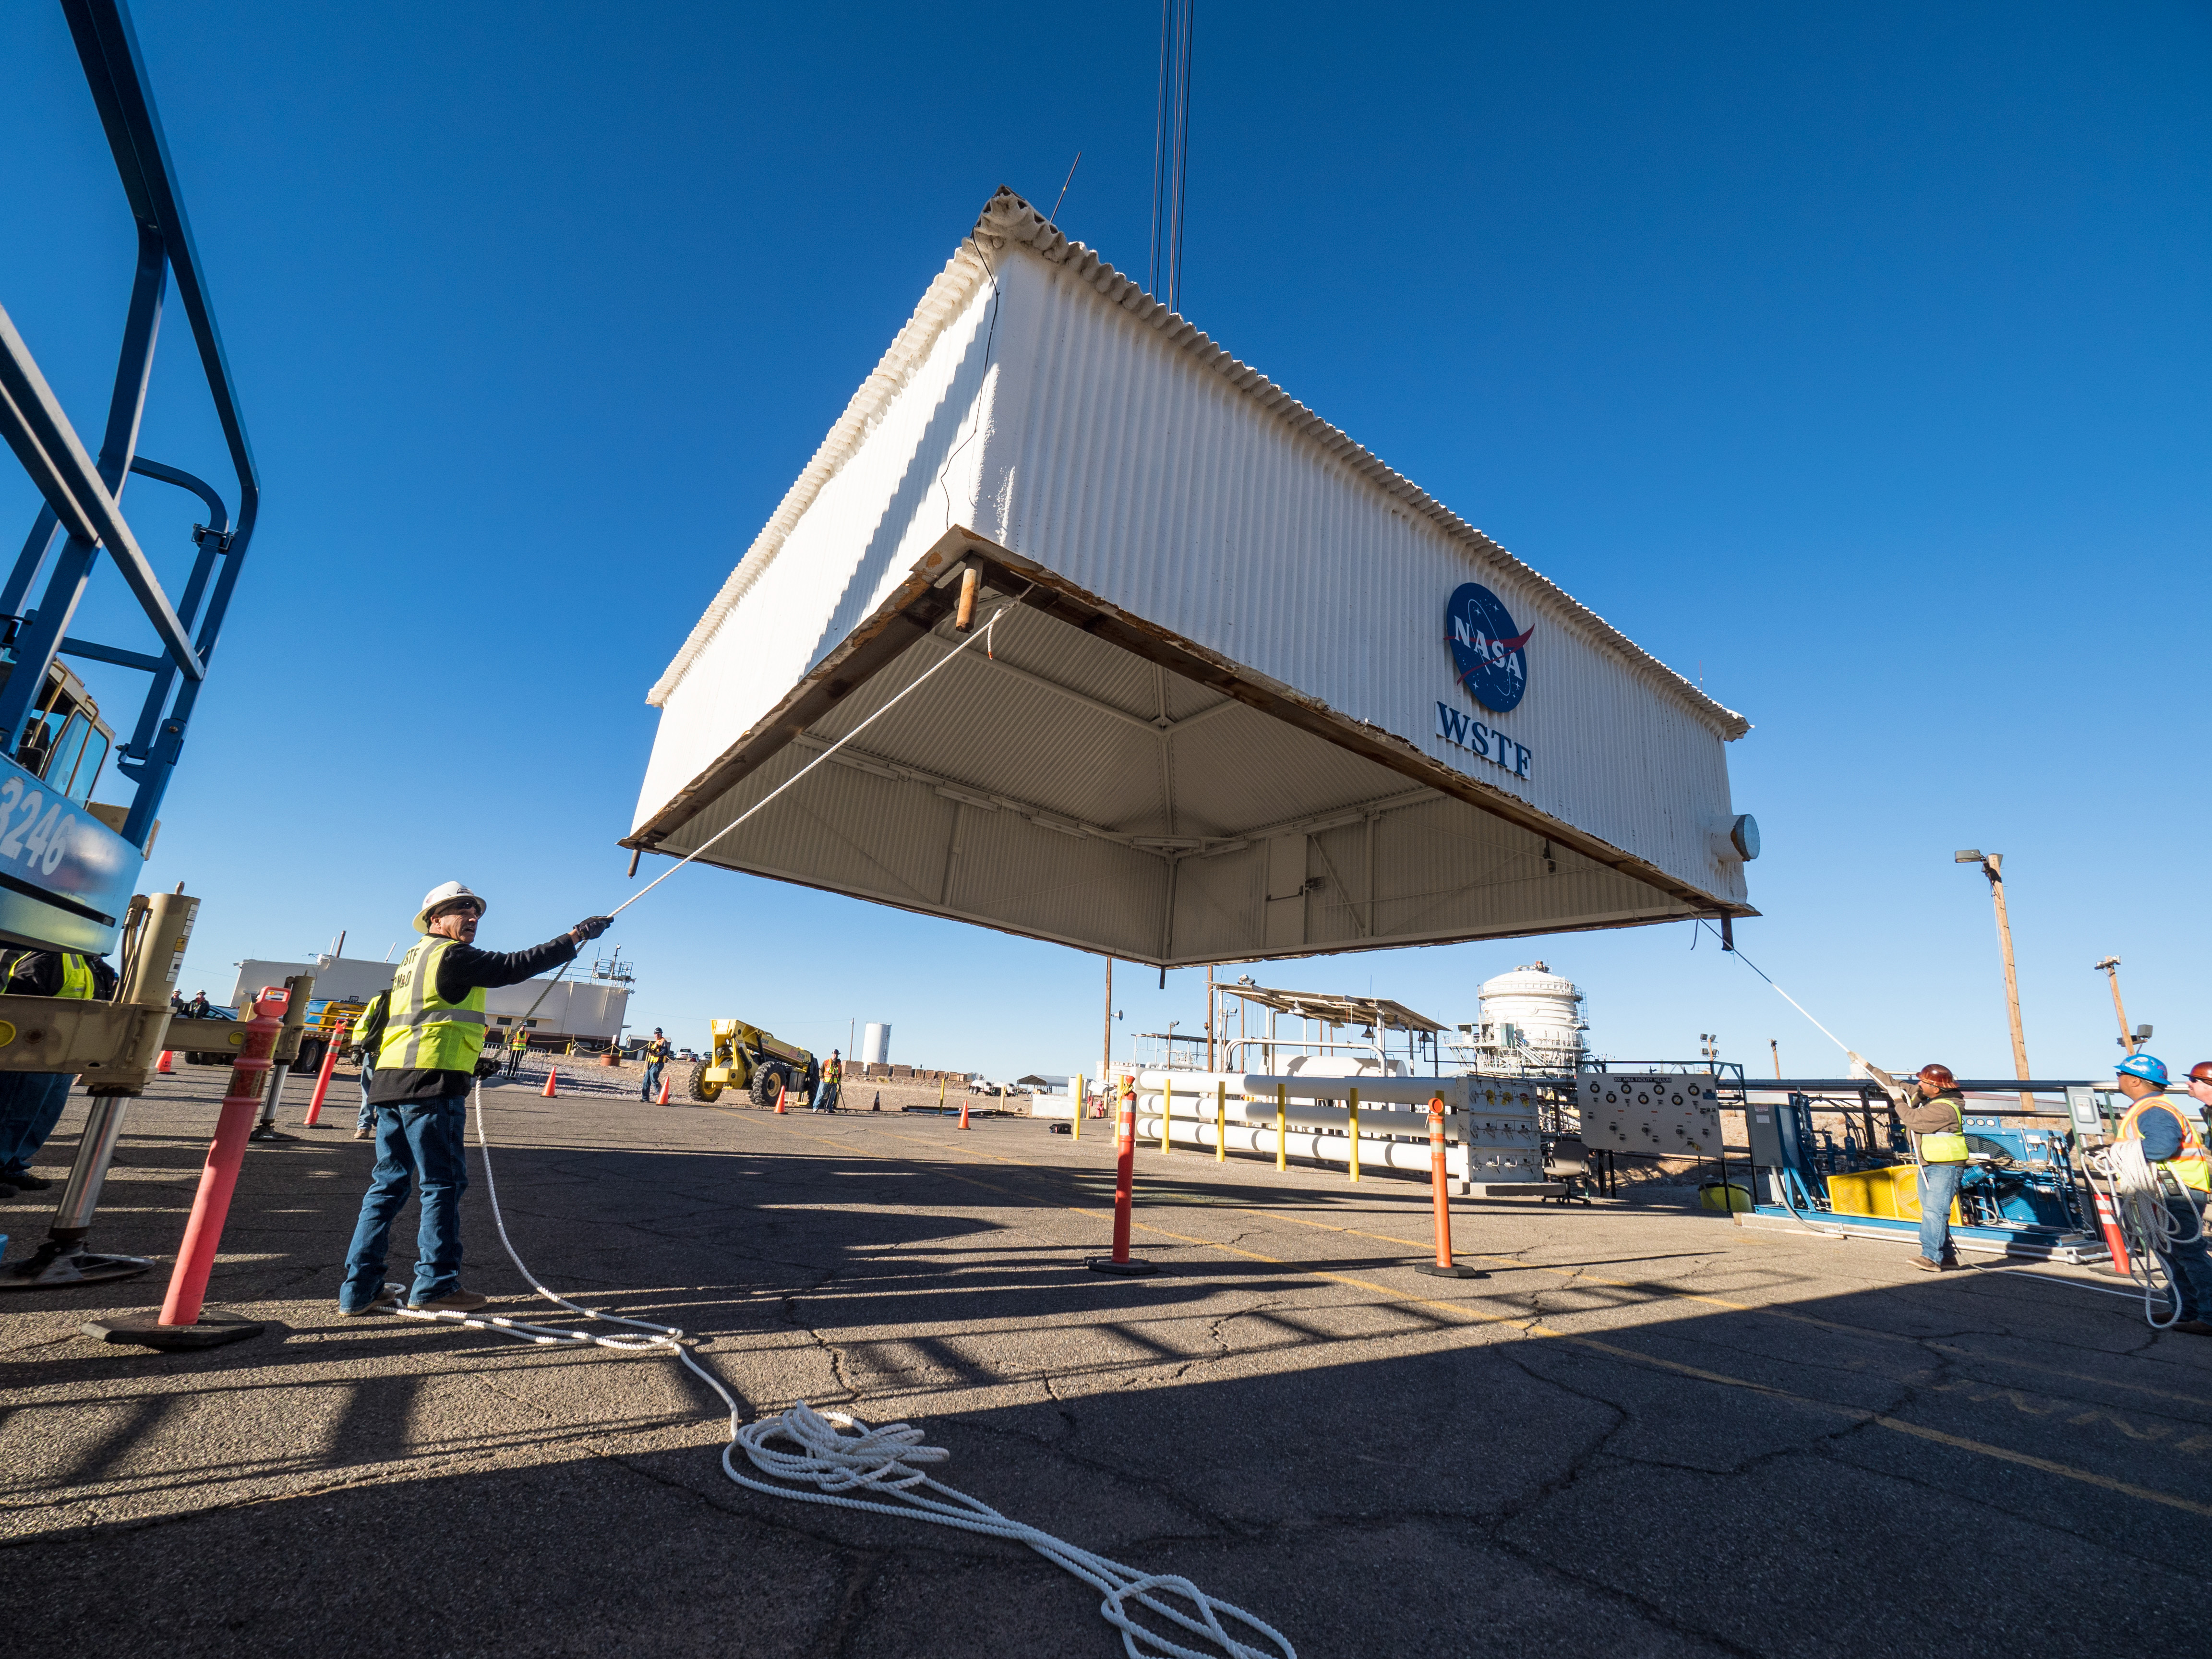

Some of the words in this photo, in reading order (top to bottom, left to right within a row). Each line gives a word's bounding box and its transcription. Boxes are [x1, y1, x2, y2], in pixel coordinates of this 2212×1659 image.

[1455, 615, 1523, 681] NASA
[1437, 701, 1531, 777] WSTF
[0, 776, 76, 875] 3246
[398, 948, 421, 968] STF
